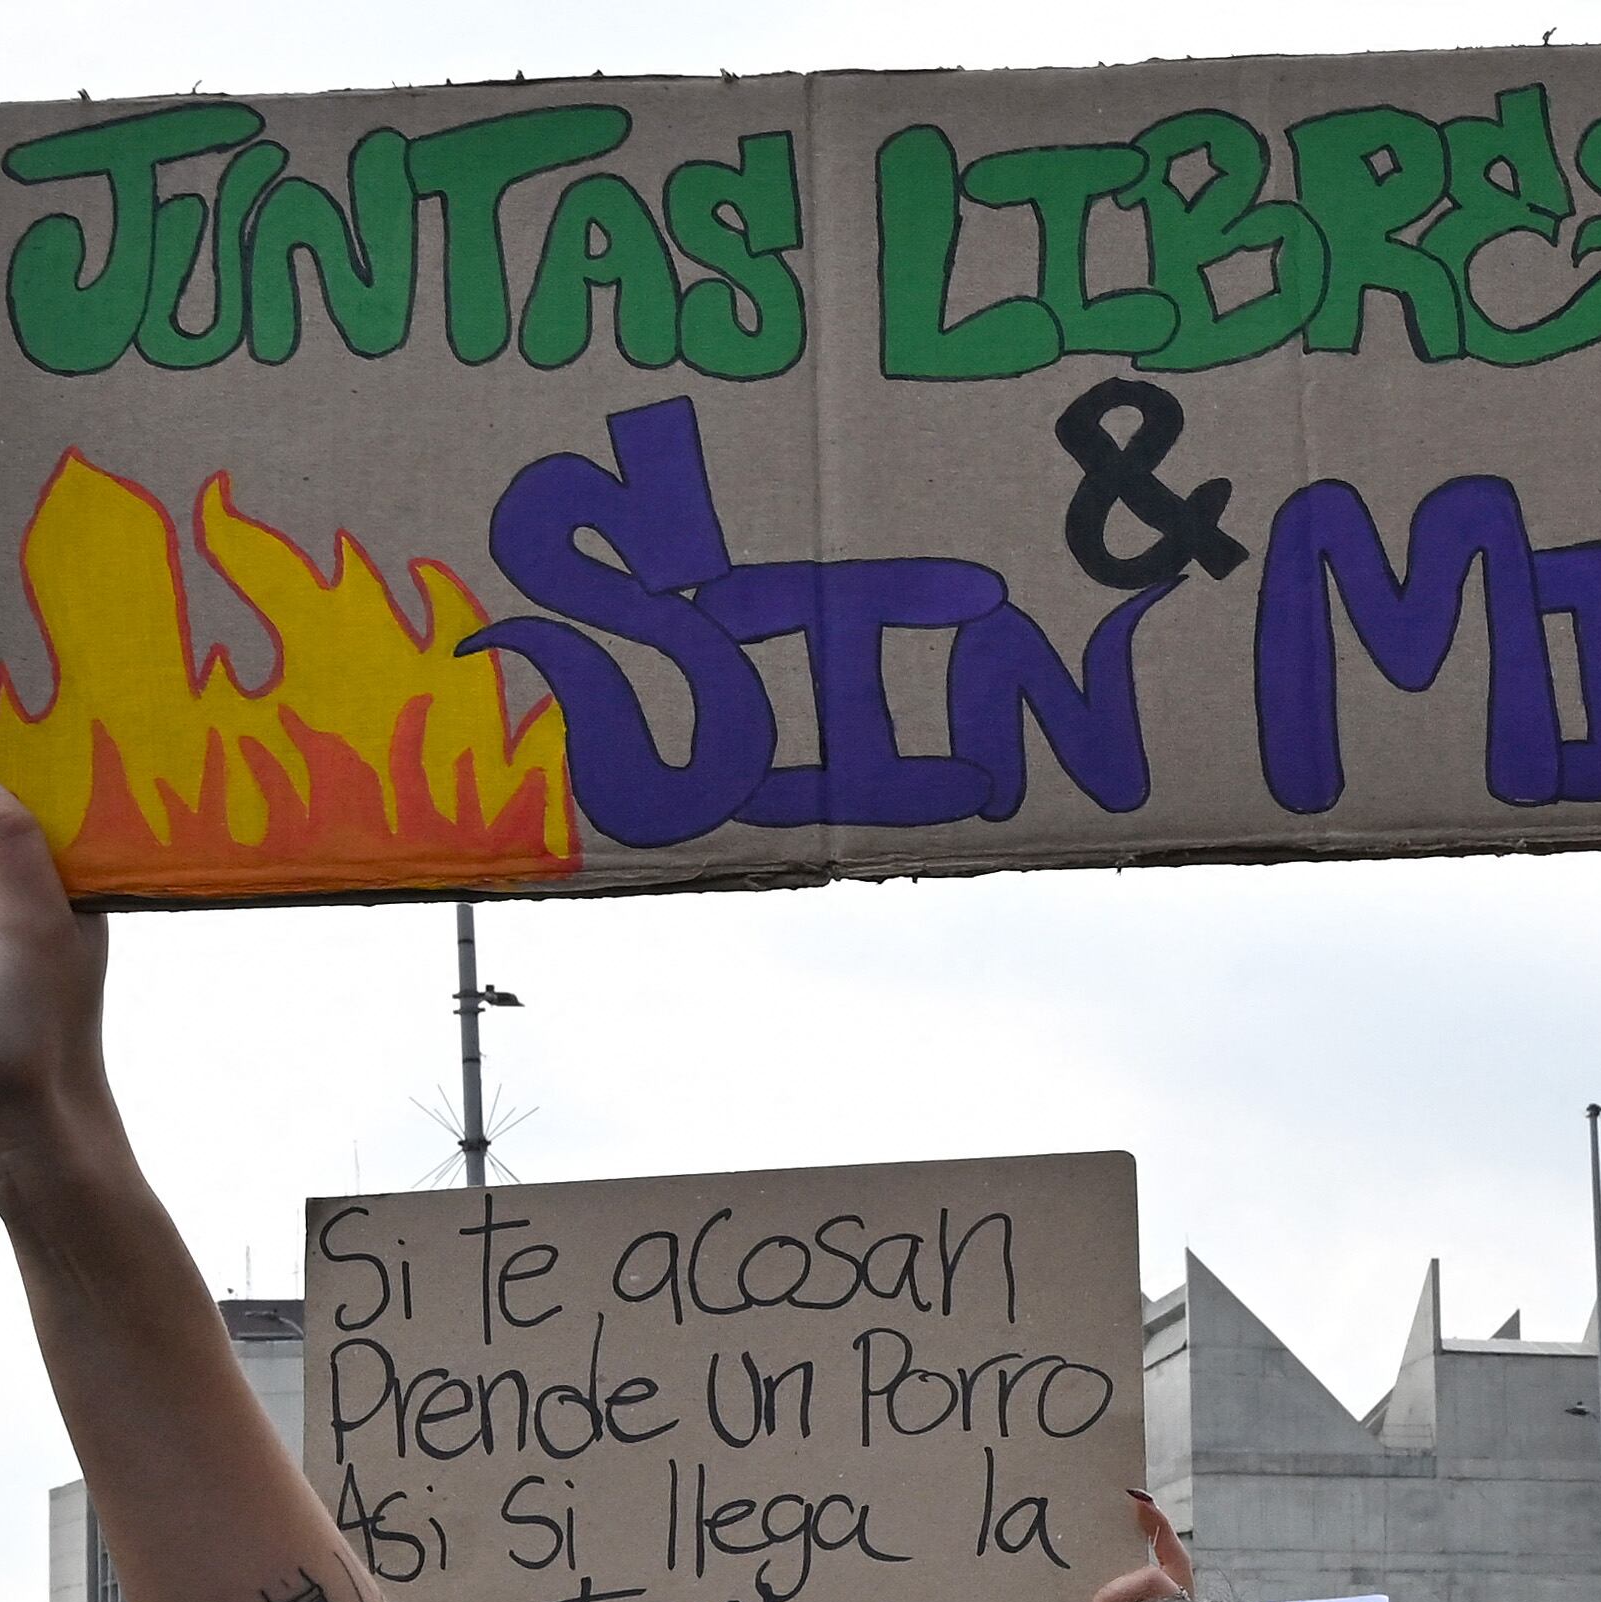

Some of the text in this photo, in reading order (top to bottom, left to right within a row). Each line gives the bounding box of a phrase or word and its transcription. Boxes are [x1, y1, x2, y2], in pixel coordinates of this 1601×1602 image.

[2, 101, 806, 380] JUNTAS
[1054, 377, 1249, 589] &
[319, 1207, 411, 1331] Si
[460, 1193, 563, 1345] te
[331, 1314, 679, 1466] Prende
[853, 1328, 1115, 1448] Porro
[336, 1463, 449, 1584] Asi
[667, 1458, 913, 1602] llega
[976, 1446, 1072, 1570] la
